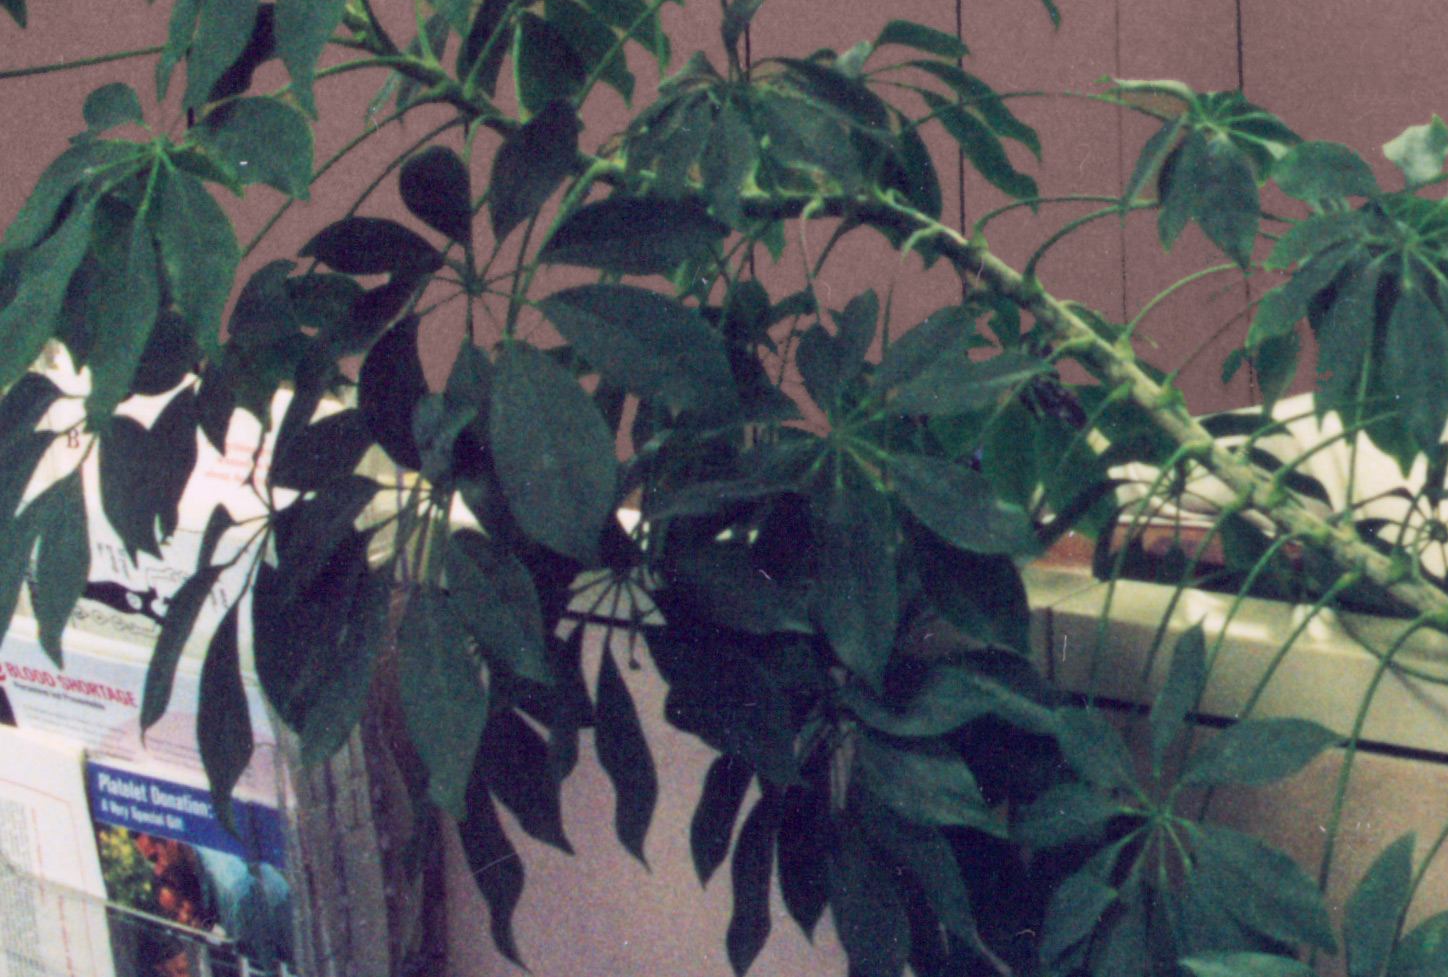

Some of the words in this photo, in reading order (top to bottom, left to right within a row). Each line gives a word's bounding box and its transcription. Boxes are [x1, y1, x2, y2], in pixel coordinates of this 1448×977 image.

[5, 662, 57, 688] BLOOD
[57, 674, 139, 708] SHORTAGE
[97, 772, 148, 803] Platelet
[150, 784, 215, 819] Donation:
